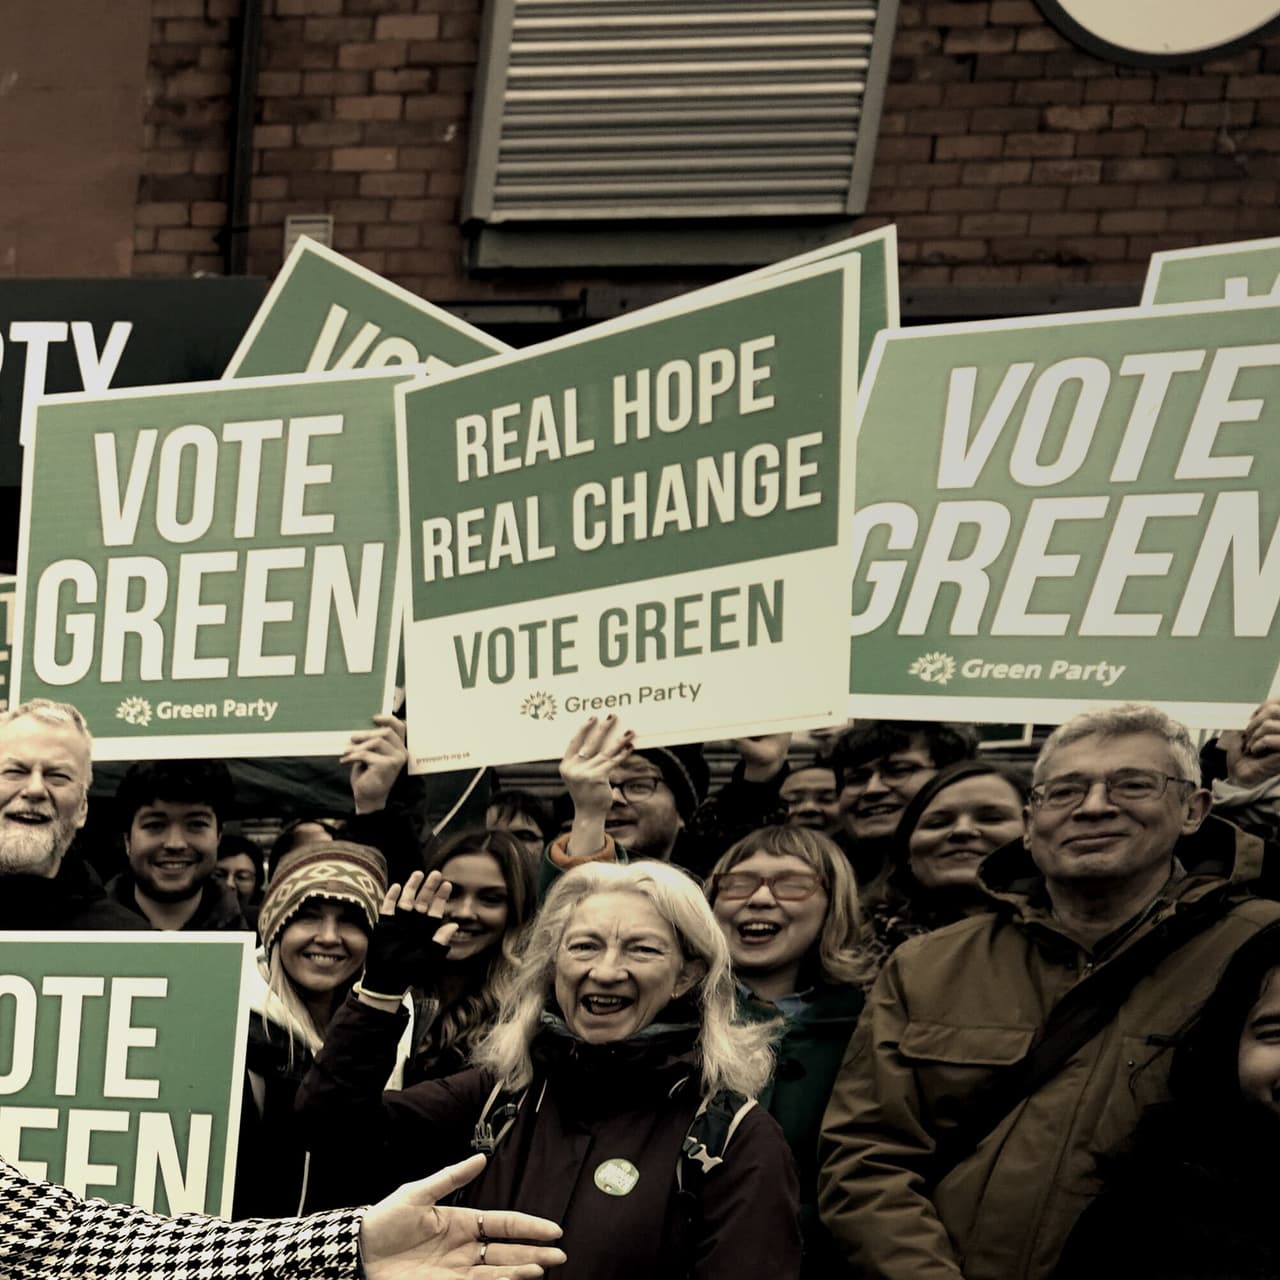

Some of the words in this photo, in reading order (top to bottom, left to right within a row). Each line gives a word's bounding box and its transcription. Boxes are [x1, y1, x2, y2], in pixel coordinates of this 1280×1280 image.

[455, 388, 595, 483] REAL
[613, 334, 776, 446] HOPE
[937, 343, 1280, 489] VOTE
[94, 414, 344, 547] VOTE
[421, 495, 555, 583] REAL
[572, 431, 823, 552] CHANGE
[32, 542, 385, 687] GREEN
[850, 489, 1280, 638] GREEN
[453, 614, 579, 690] VOTE
[598, 578, 784, 668] GREEN
[564, 692, 632, 713] Green
[639, 682, 702, 703] Party
[961, 659, 1041, 682] Green
[1049, 659, 1126, 687] Party
[157, 700, 217, 720] Green
[222, 696, 278, 720] Party
